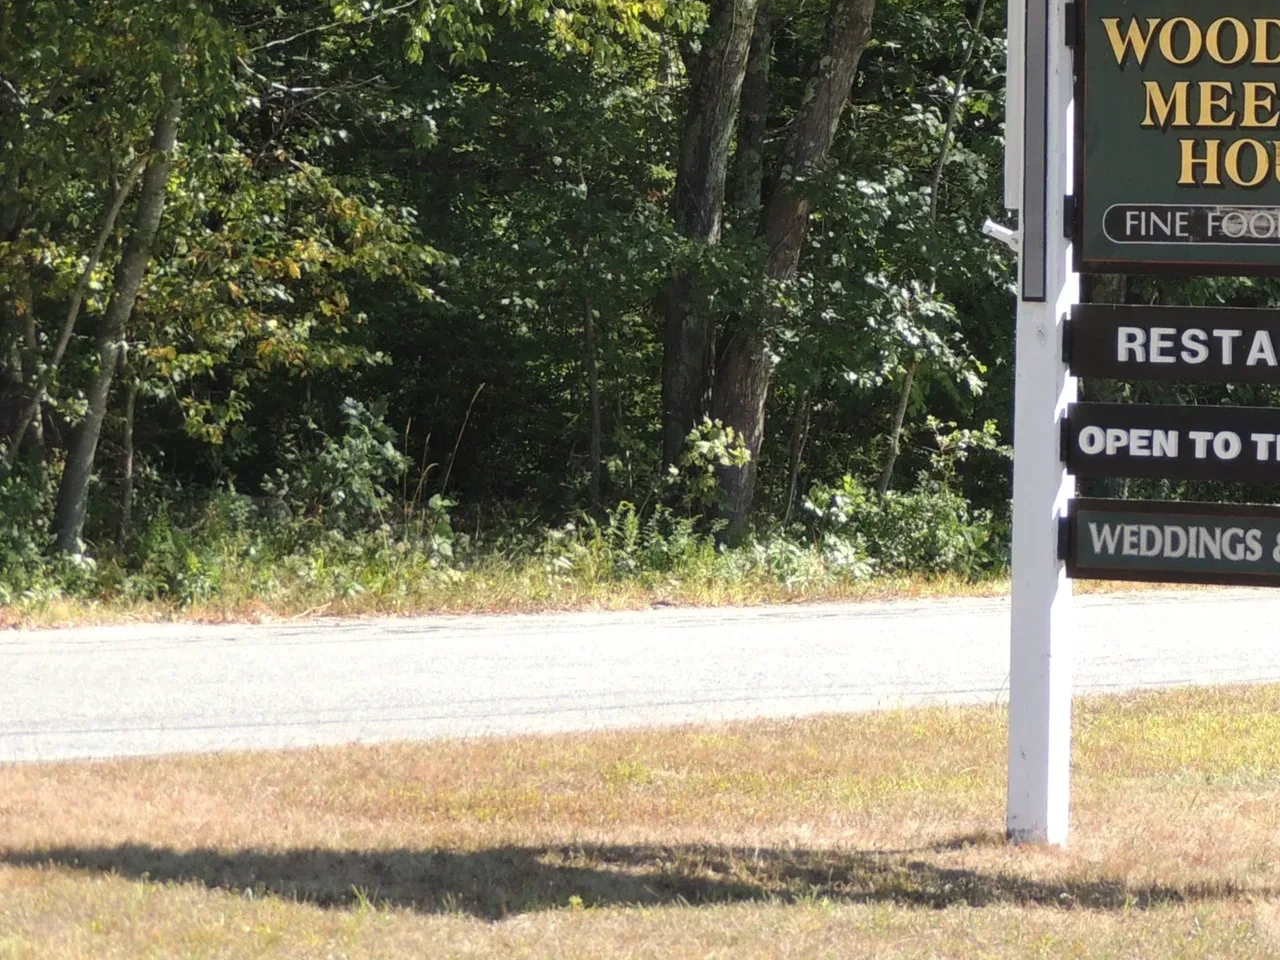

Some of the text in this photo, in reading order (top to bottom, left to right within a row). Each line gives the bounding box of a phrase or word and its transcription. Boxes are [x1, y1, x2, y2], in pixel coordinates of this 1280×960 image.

[1125, 210, 1189, 237] FINE
[1078, 426, 1179, 458] OPEN
[1189, 430, 1242, 460] TO
[1087, 522, 1263, 562] WEDDINGS
